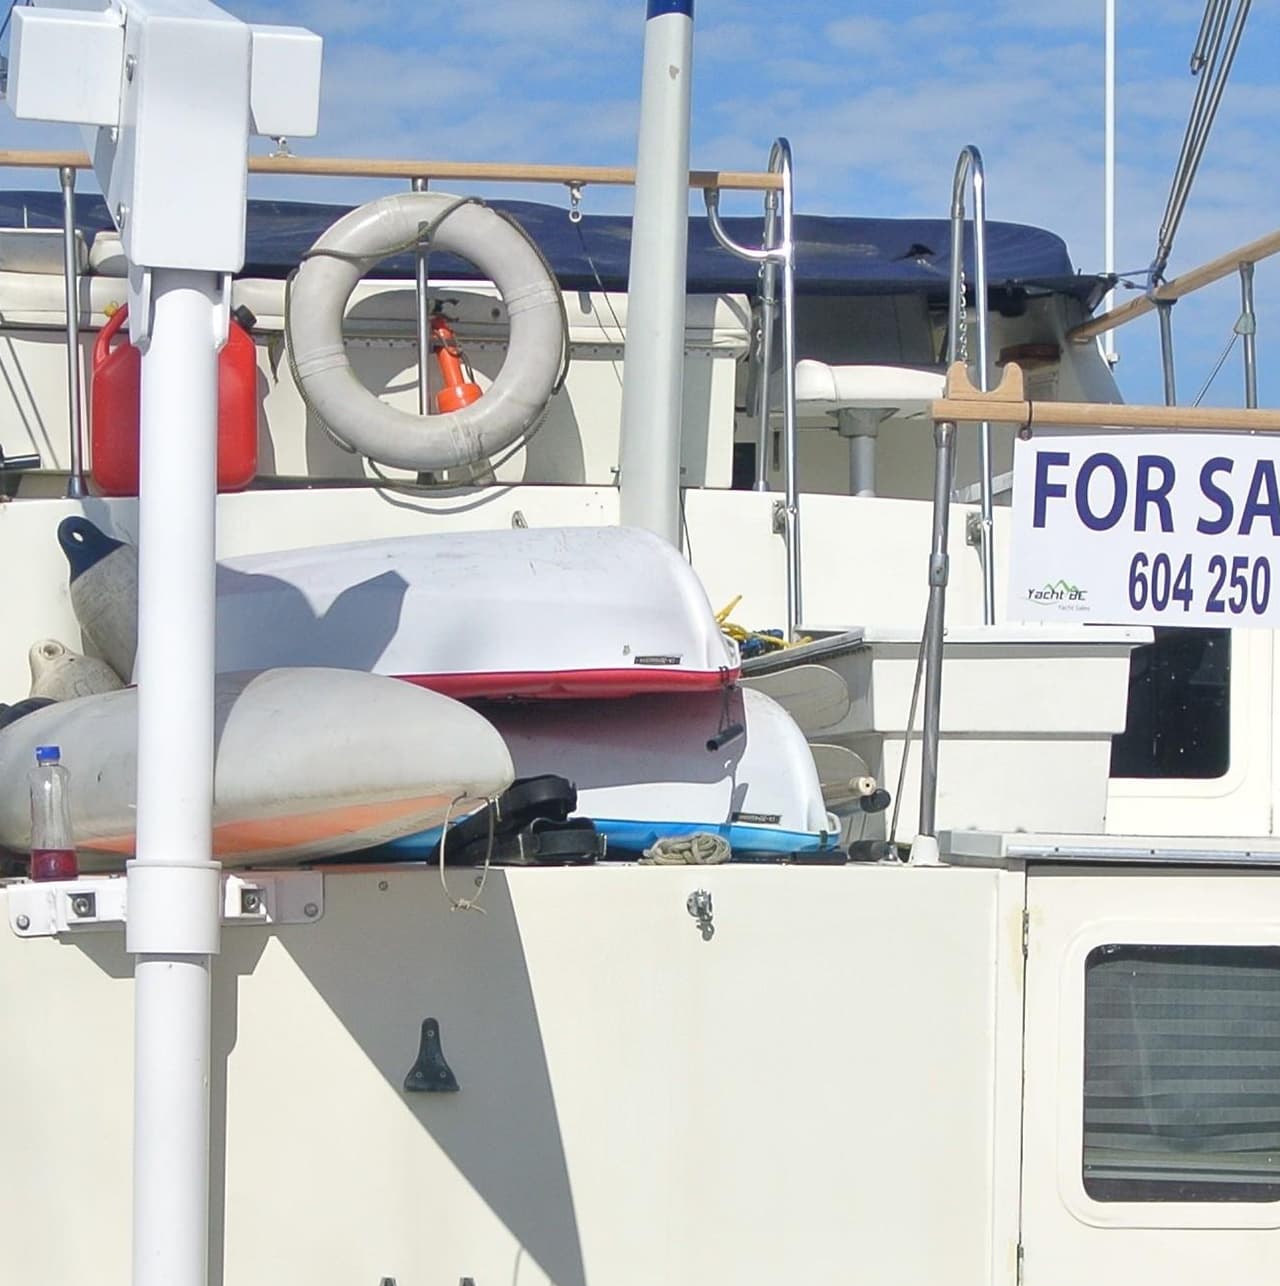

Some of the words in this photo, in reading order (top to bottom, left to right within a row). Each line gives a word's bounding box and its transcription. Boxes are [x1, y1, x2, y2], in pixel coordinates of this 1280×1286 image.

[1033, 451, 1176, 532] FOR
[1027, 588, 1065, 601] Yacht
[1128, 551, 1193, 612] 604
[1205, 554, 1270, 615] 250
